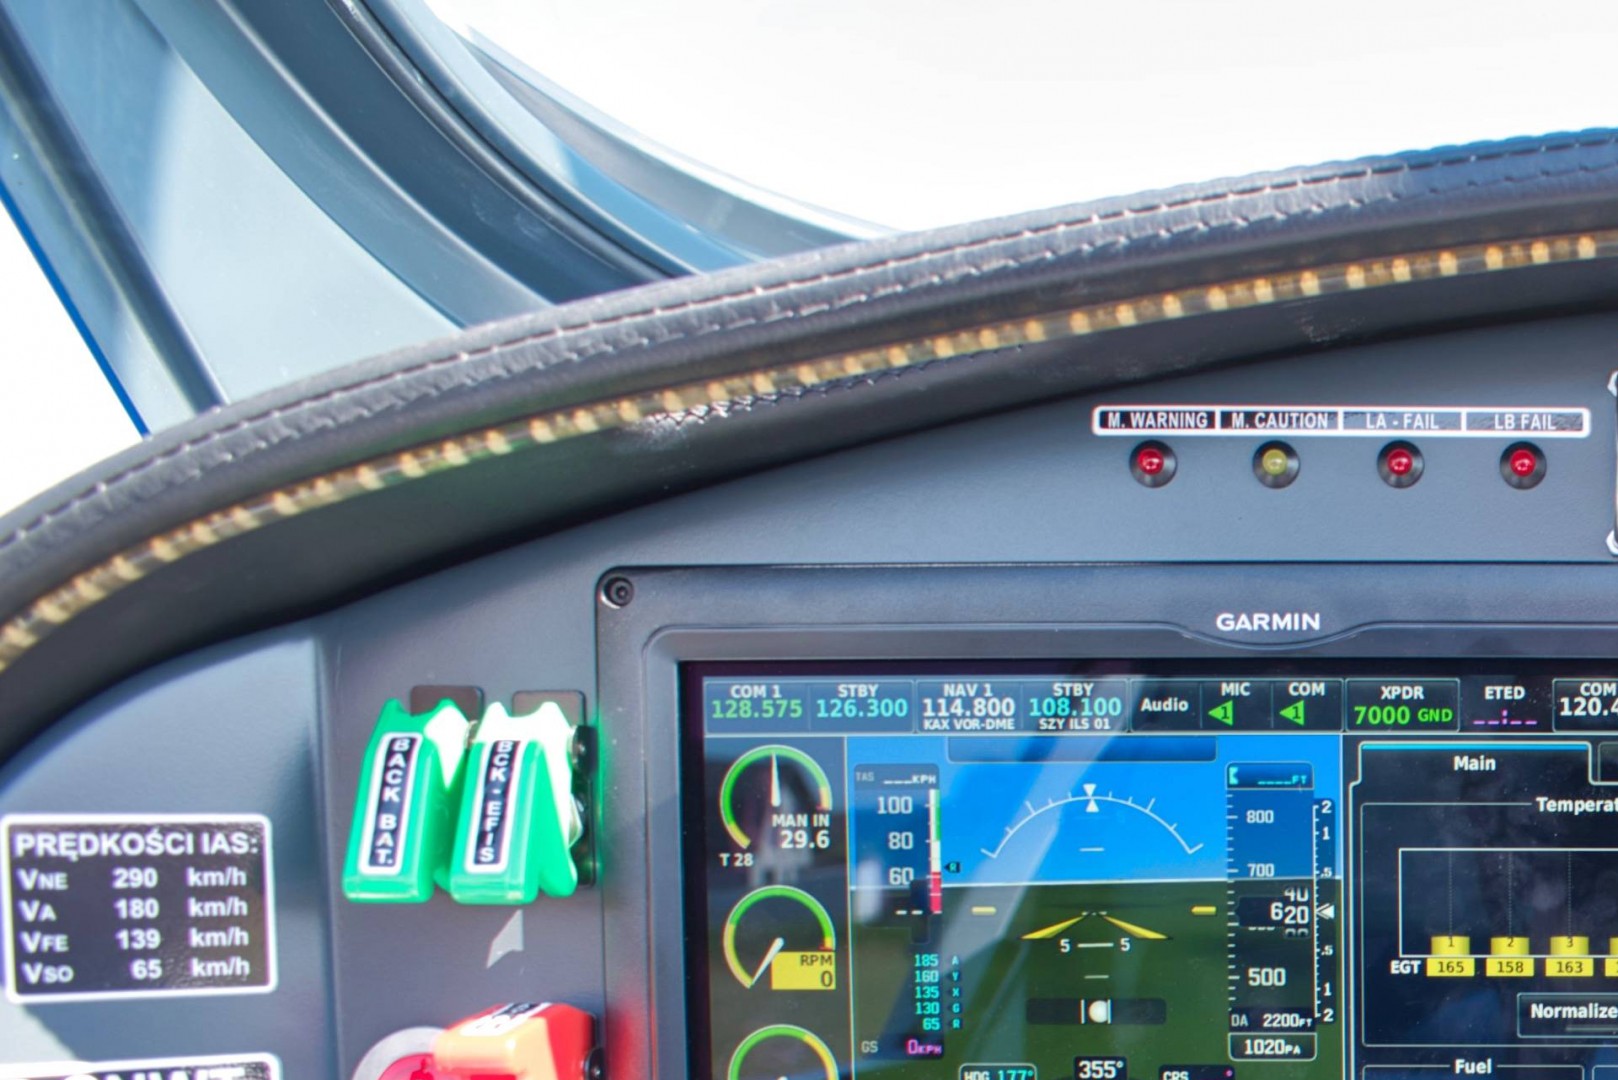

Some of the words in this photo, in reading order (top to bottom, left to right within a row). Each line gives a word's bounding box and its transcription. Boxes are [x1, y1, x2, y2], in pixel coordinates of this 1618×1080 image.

[1107, 411, 1126, 429] M.
[1130, 411, 1209, 430] WARNING
[1231, 411, 1249, 429] M.
[1253, 412, 1329, 430] CAUTION
[1365, 412, 1386, 430] LA
[1402, 413, 1440, 430] FAIL
[1494, 413, 1516, 431] LB
[1519, 413, 1557, 432] FAIL
[1215, 612, 1321, 631] GARMIN
[837, 684, 879, 699] STBY
[1052, 683, 1095, 697] STBY
[1484, 686, 1526, 701] ETED
[711, 699, 803, 719] 128.575
[815, 698, 908, 718] 126.300
[922, 698, 1016, 717] 114.800
[1029, 698, 1122, 717] 108.100
[1140, 698, 1190, 713] Audio
[923, 718, 950, 731] KAX
[953, 717, 1016, 731] VOR-DME
[1354, 706, 1411, 725] 7000
[1416, 708, 1453, 724] GND
[382, 738, 411, 803] BACK
[1453, 755, 1497, 772] Main
[877, 796, 913, 815] 100
[1246, 809, 1275, 824] 800
[13, 827, 194, 862] PRĘDKOŚCI
[202, 831, 259, 855] IAS:
[375, 813, 397, 865] BAT.
[781, 830, 830, 849] 29.6
[111, 867, 159, 889] 290
[186, 867, 247, 887] km/h
[1247, 862, 1275, 878] 700
[114, 898, 160, 919] 180
[187, 897, 249, 918] km/h
[130, 959, 163, 980] 65
[190, 956, 251, 979] km/h
[800, 953, 834, 967] RPM
[1247, 967, 1287, 987] 500
[914, 986, 940, 999] 135
[1530, 1003, 1618, 1020] Normalize
[1454, 1059, 1493, 1075] Fuel
